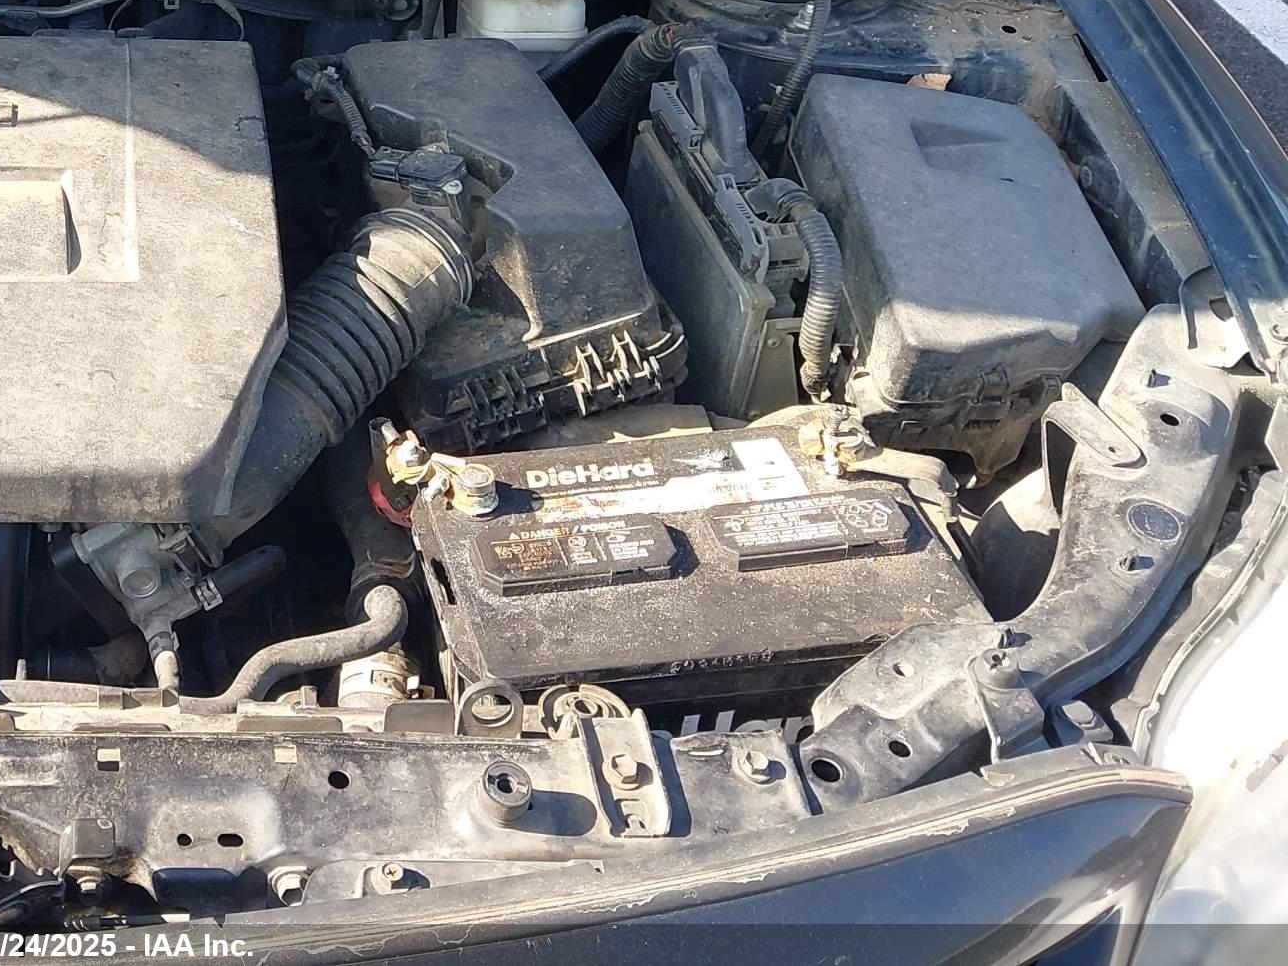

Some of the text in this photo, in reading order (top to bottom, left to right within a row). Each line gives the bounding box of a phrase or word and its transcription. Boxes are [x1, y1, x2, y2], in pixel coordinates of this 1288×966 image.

[525, 458, 655, 489] DieHard
[520, 527, 570, 540] DANGER
[580, 521, 626, 533] POISON
